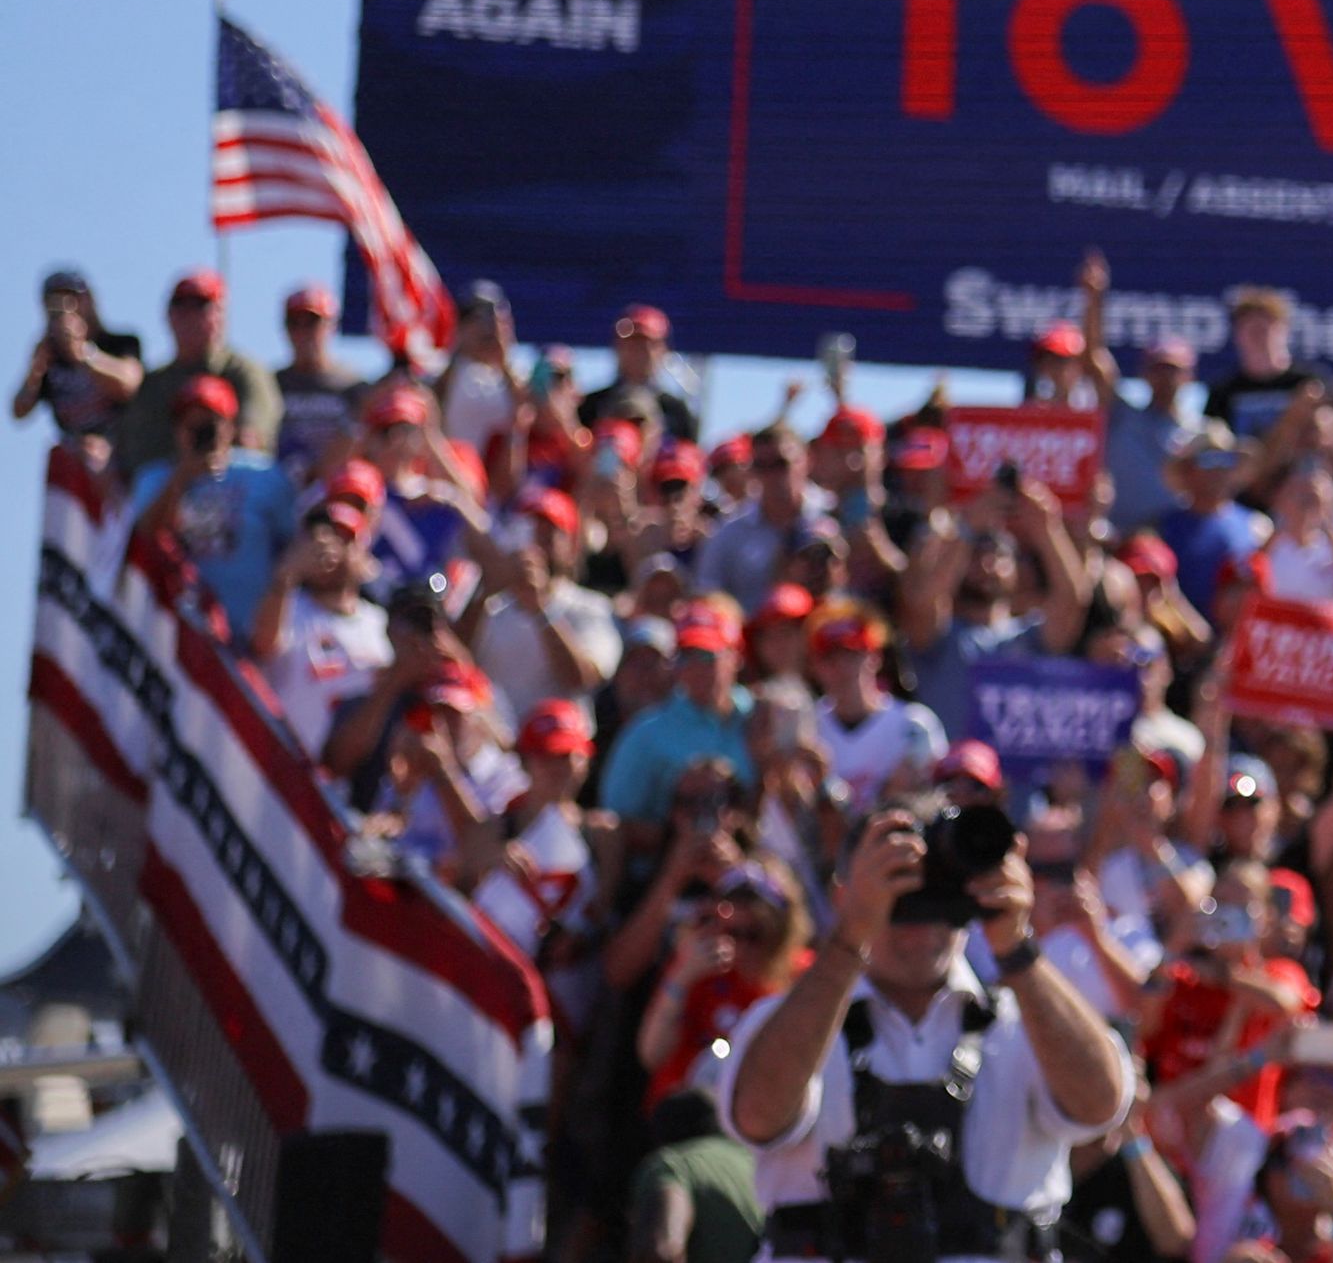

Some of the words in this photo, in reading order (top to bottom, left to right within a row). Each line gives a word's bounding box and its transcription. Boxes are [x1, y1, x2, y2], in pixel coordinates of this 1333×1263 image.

[1048, 163, 1152, 210] MAIL
[954, 424, 1096, 459] TRUMP
[978, 686, 1136, 722] TRUMP
